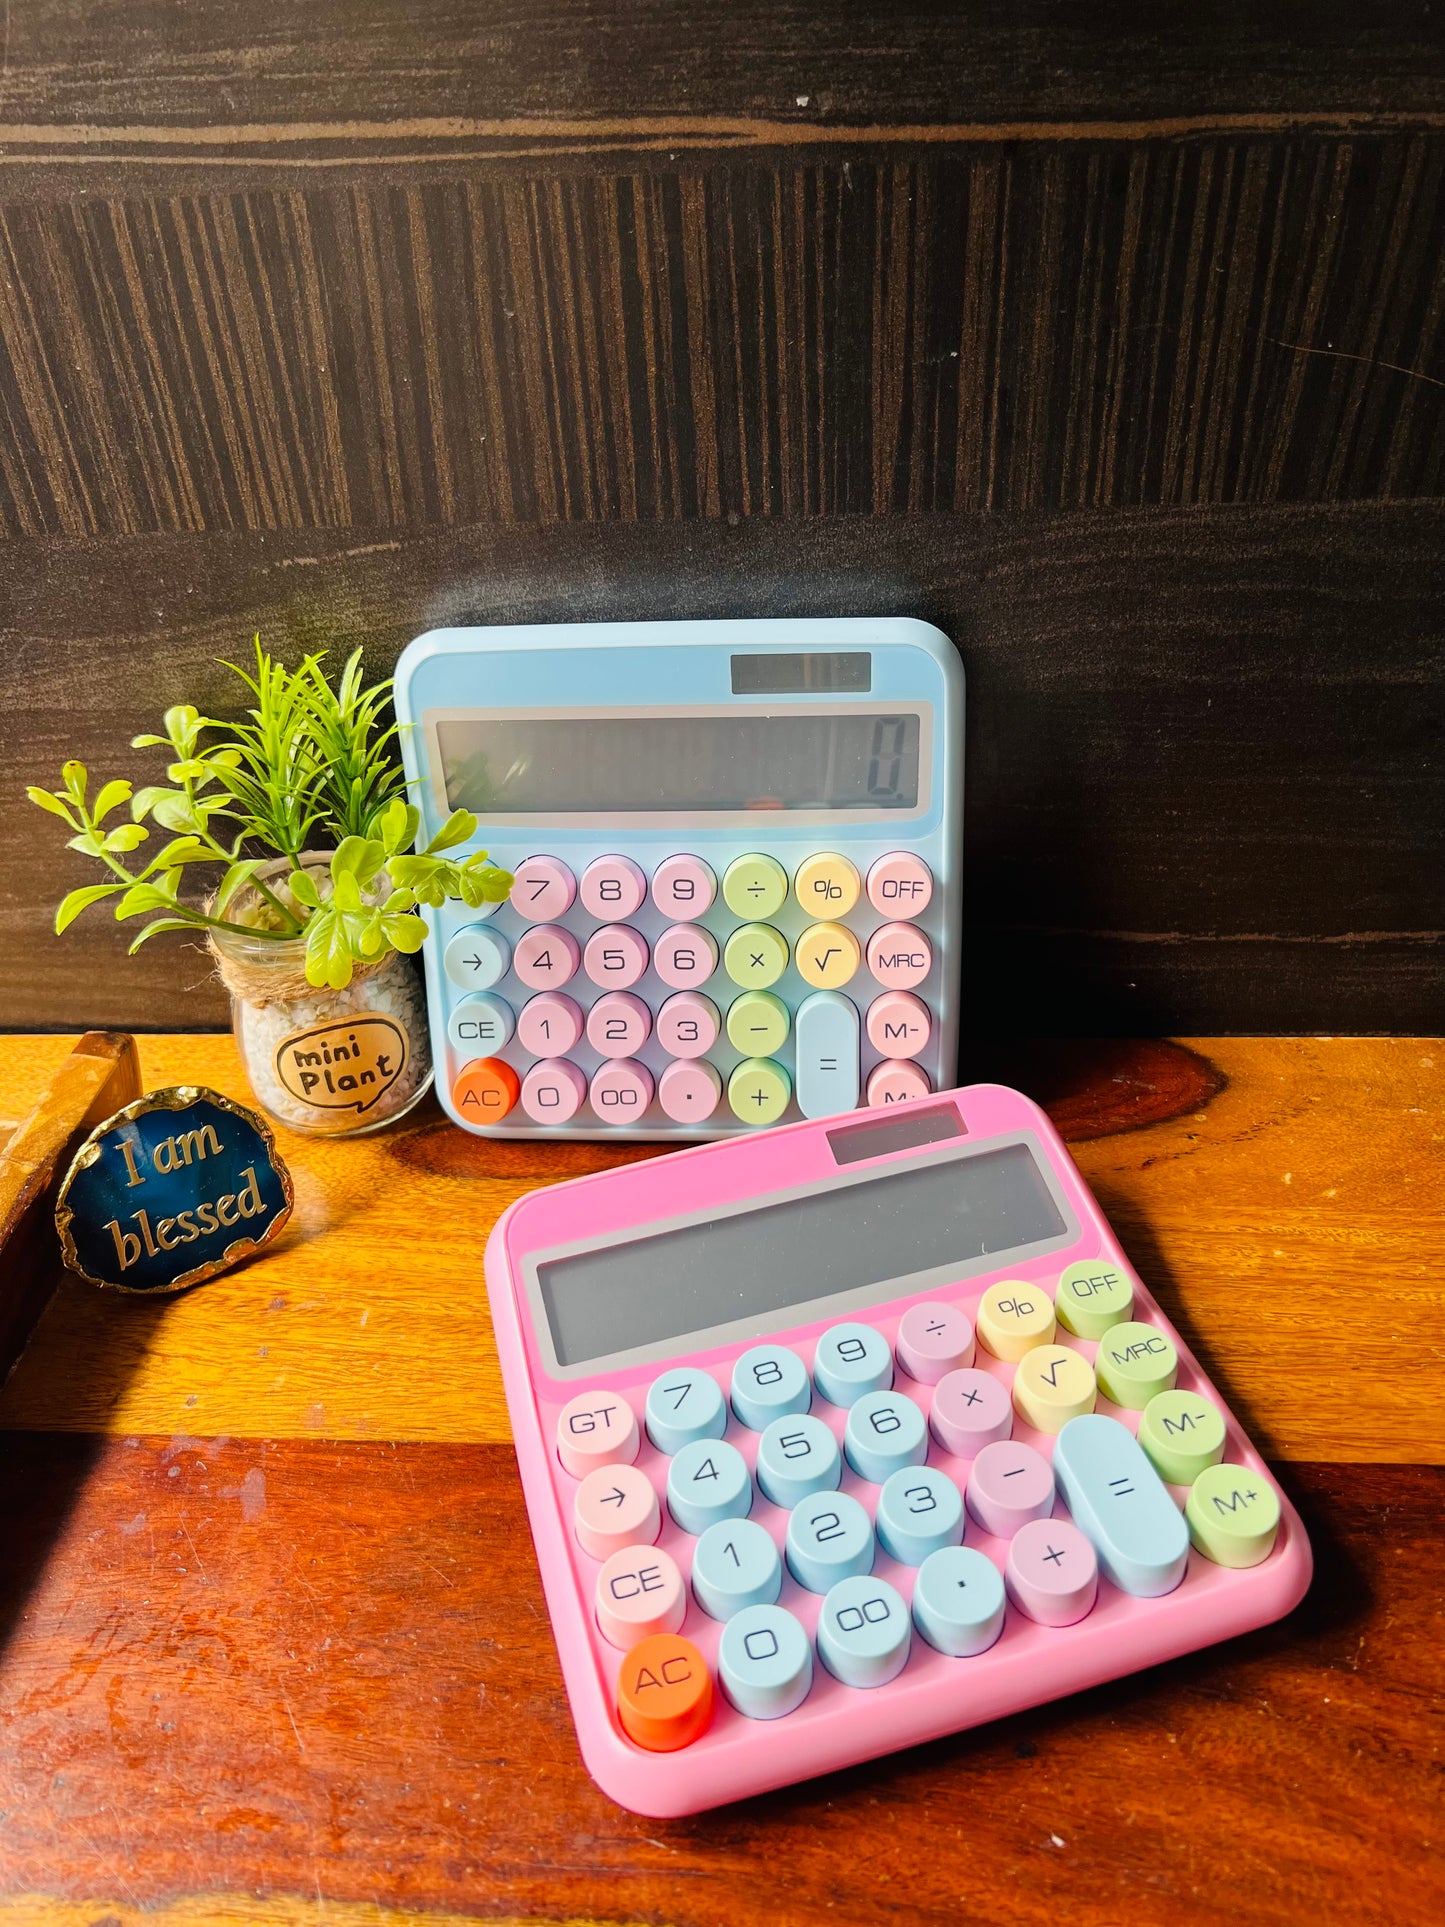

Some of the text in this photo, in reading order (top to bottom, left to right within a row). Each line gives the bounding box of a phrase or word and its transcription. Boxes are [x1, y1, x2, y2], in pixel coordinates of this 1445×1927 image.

[527, 880, 550, 900] 7
[600, 880, 622, 900] 8
[673, 880, 694, 900] 9
[882, 880, 924, 899] OFF
[532, 951, 553, 970] 4
[604, 950, 625, 969] 5
[674, 950, 695, 969] 6
[879, 954, 924, 968] MRC
[458, 1022, 495, 1038] CE
[540, 1020, 550, 1039] 1
[606, 1020, 627, 1039] 2
[677, 1021, 698, 1040] 3
[885, 1024, 919, 1038] M-
[294, 1034, 360, 1067] mini
[299, 1055, 393, 1095] Plant
[462, 1090, 500, 1106] AC
[538, 1087, 559, 1106] 0
[113, 1124, 224, 1188] I am
[102, 1166, 267, 1271] blessed
[1072, 1274, 1119, 1297] OFF
[837, 1339, 867, 1362] 9
[1112, 1338, 1167, 1364] MRC
[753, 1361, 783, 1385] 8
[664, 1384, 692, 1409] 7
[570, 1407, 616, 1434] GT
[870, 1409, 900, 1434] 6
[1163, 1412, 1205, 1435] M-
[780, 1433, 811, 1458] 5
[693, 1458, 719, 1480] 4
[905, 1486, 936, 1513] 3
[1213, 1491, 1257, 1515] M+
[811, 1513, 845, 1542] 2
[724, 1543, 740, 1567] 1
[611, 1566, 664, 1599] CE
[744, 1630, 778, 1660] 0
[634, 1657, 691, 1695] AC
